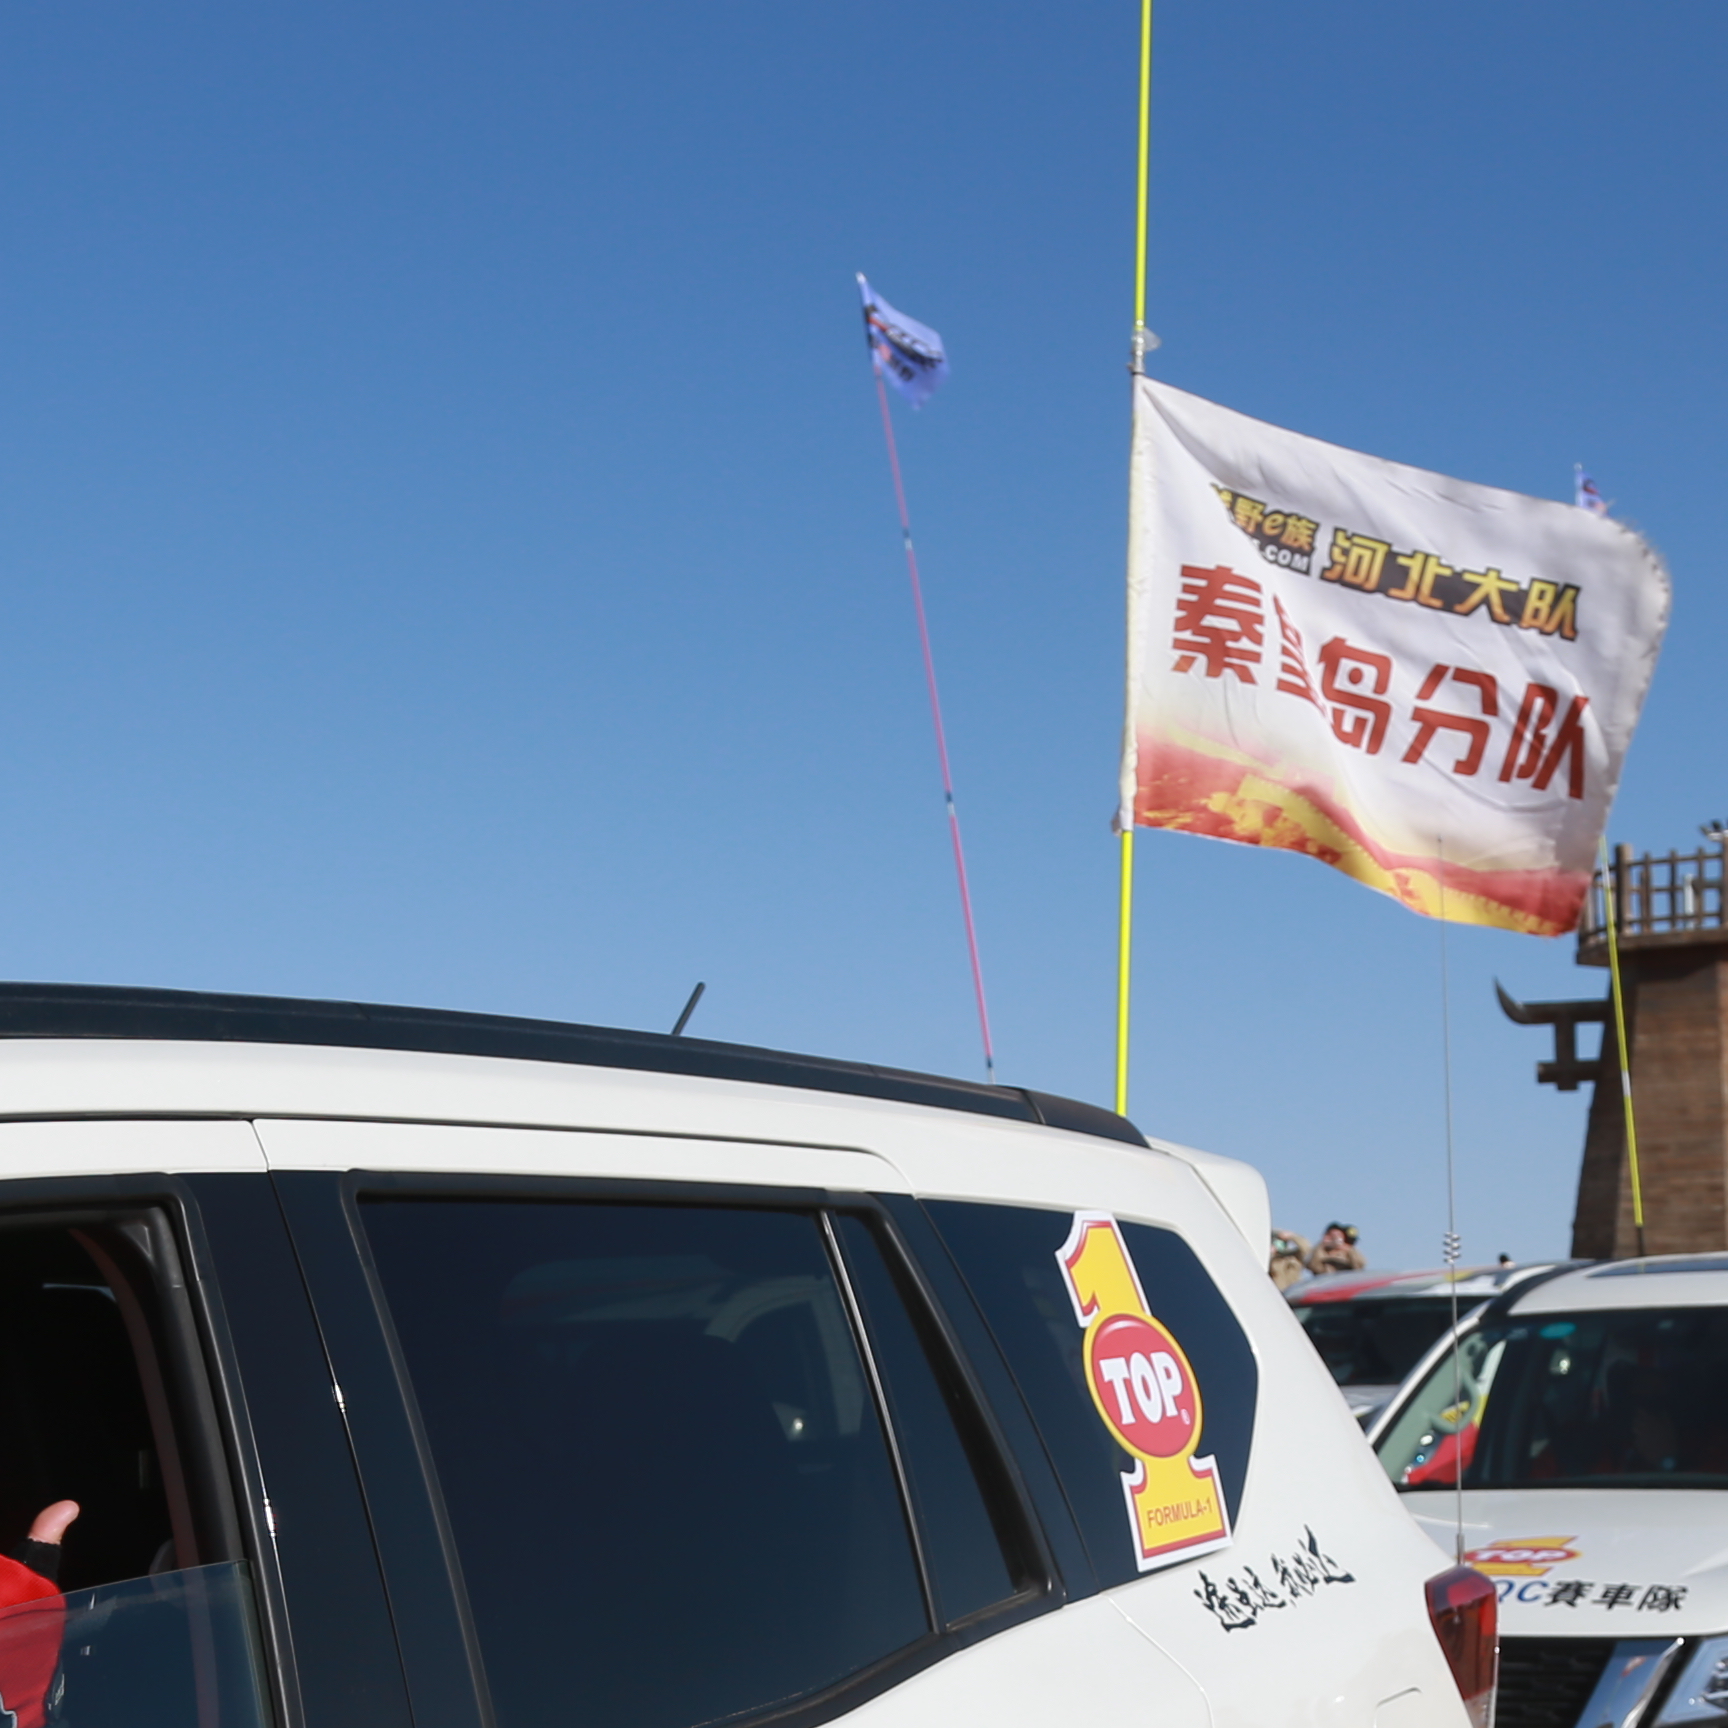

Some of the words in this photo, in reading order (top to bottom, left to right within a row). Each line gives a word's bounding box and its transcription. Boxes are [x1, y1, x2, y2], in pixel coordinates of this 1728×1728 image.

[1323, 528, 1580, 640] 河北大队
[1099, 1351, 1184, 1425] TOP
[1147, 1497, 1214, 1529] FORMULA-1
[1474, 1549, 1562, 1561] TOP
